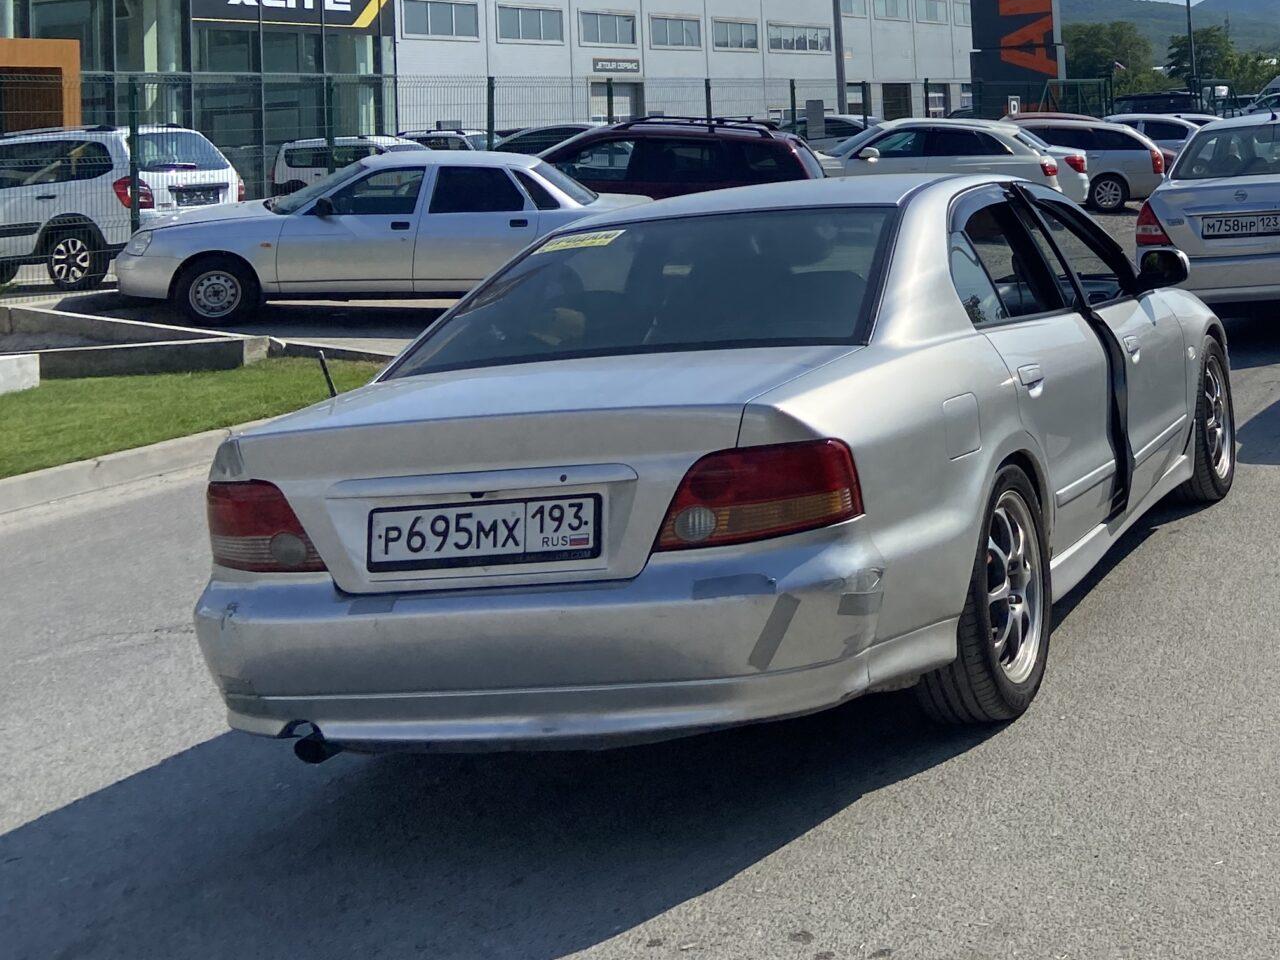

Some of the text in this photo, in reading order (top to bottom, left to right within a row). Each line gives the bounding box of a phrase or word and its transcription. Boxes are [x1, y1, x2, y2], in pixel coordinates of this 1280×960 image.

[1259, 217, 1279, 227] 123
[384, 502, 584, 555] Р695МХ 193
[541, 534, 569, 548] RUS
